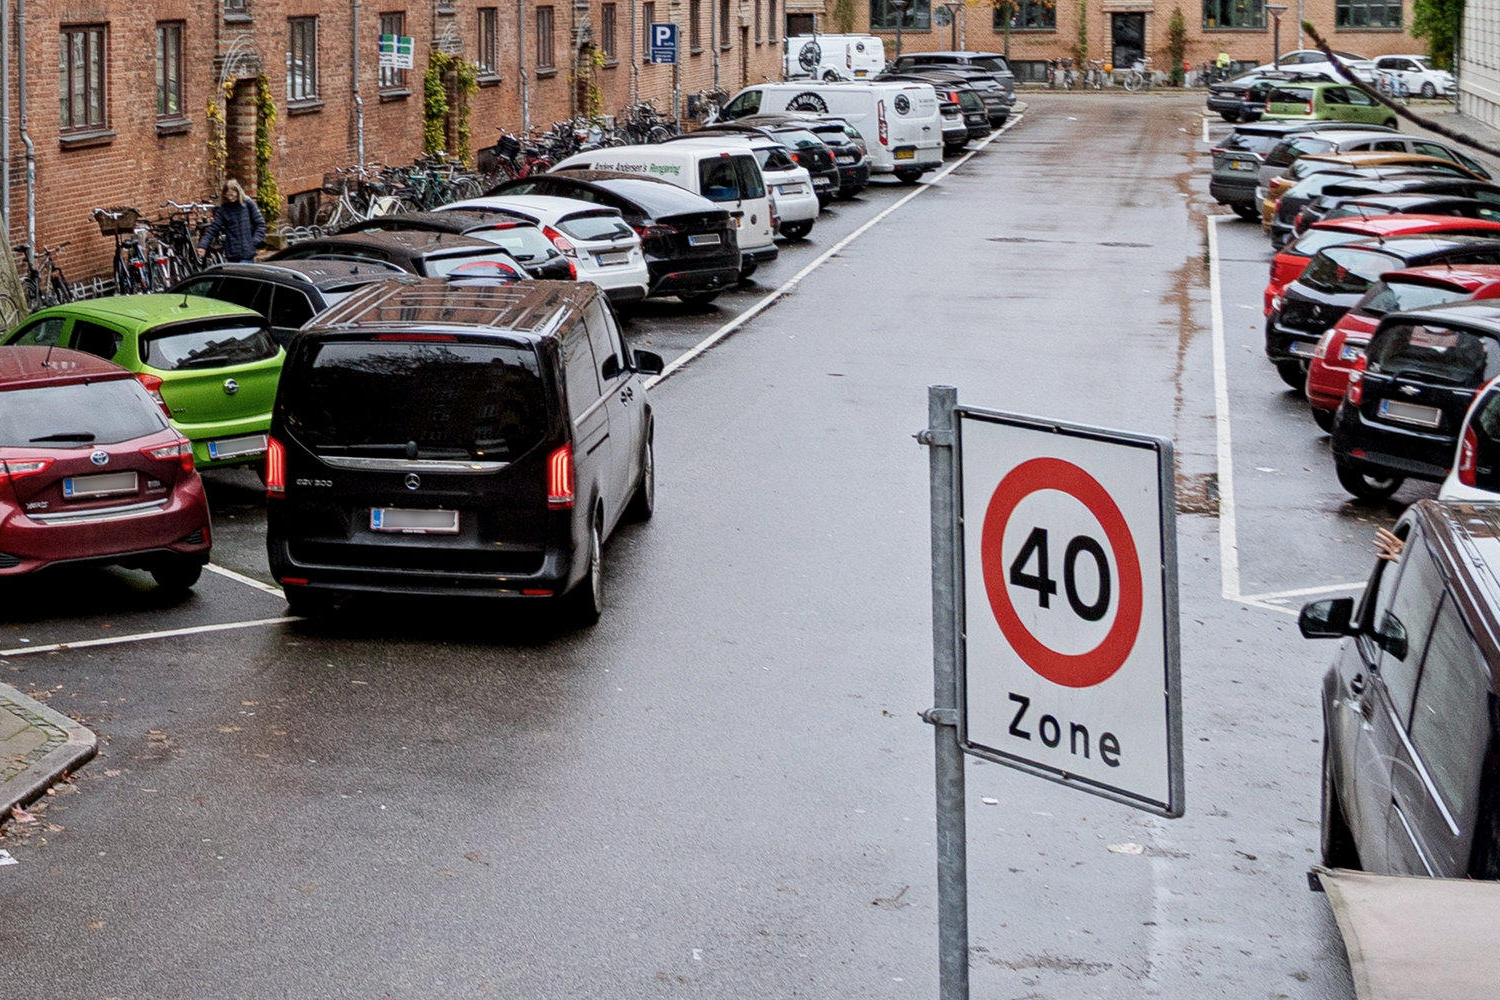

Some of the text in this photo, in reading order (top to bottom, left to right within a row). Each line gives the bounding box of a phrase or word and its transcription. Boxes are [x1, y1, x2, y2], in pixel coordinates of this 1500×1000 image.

[656, 26, 671, 46] P
[1010, 526, 1112, 622] 40
[1008, 691, 1122, 768] Zone
